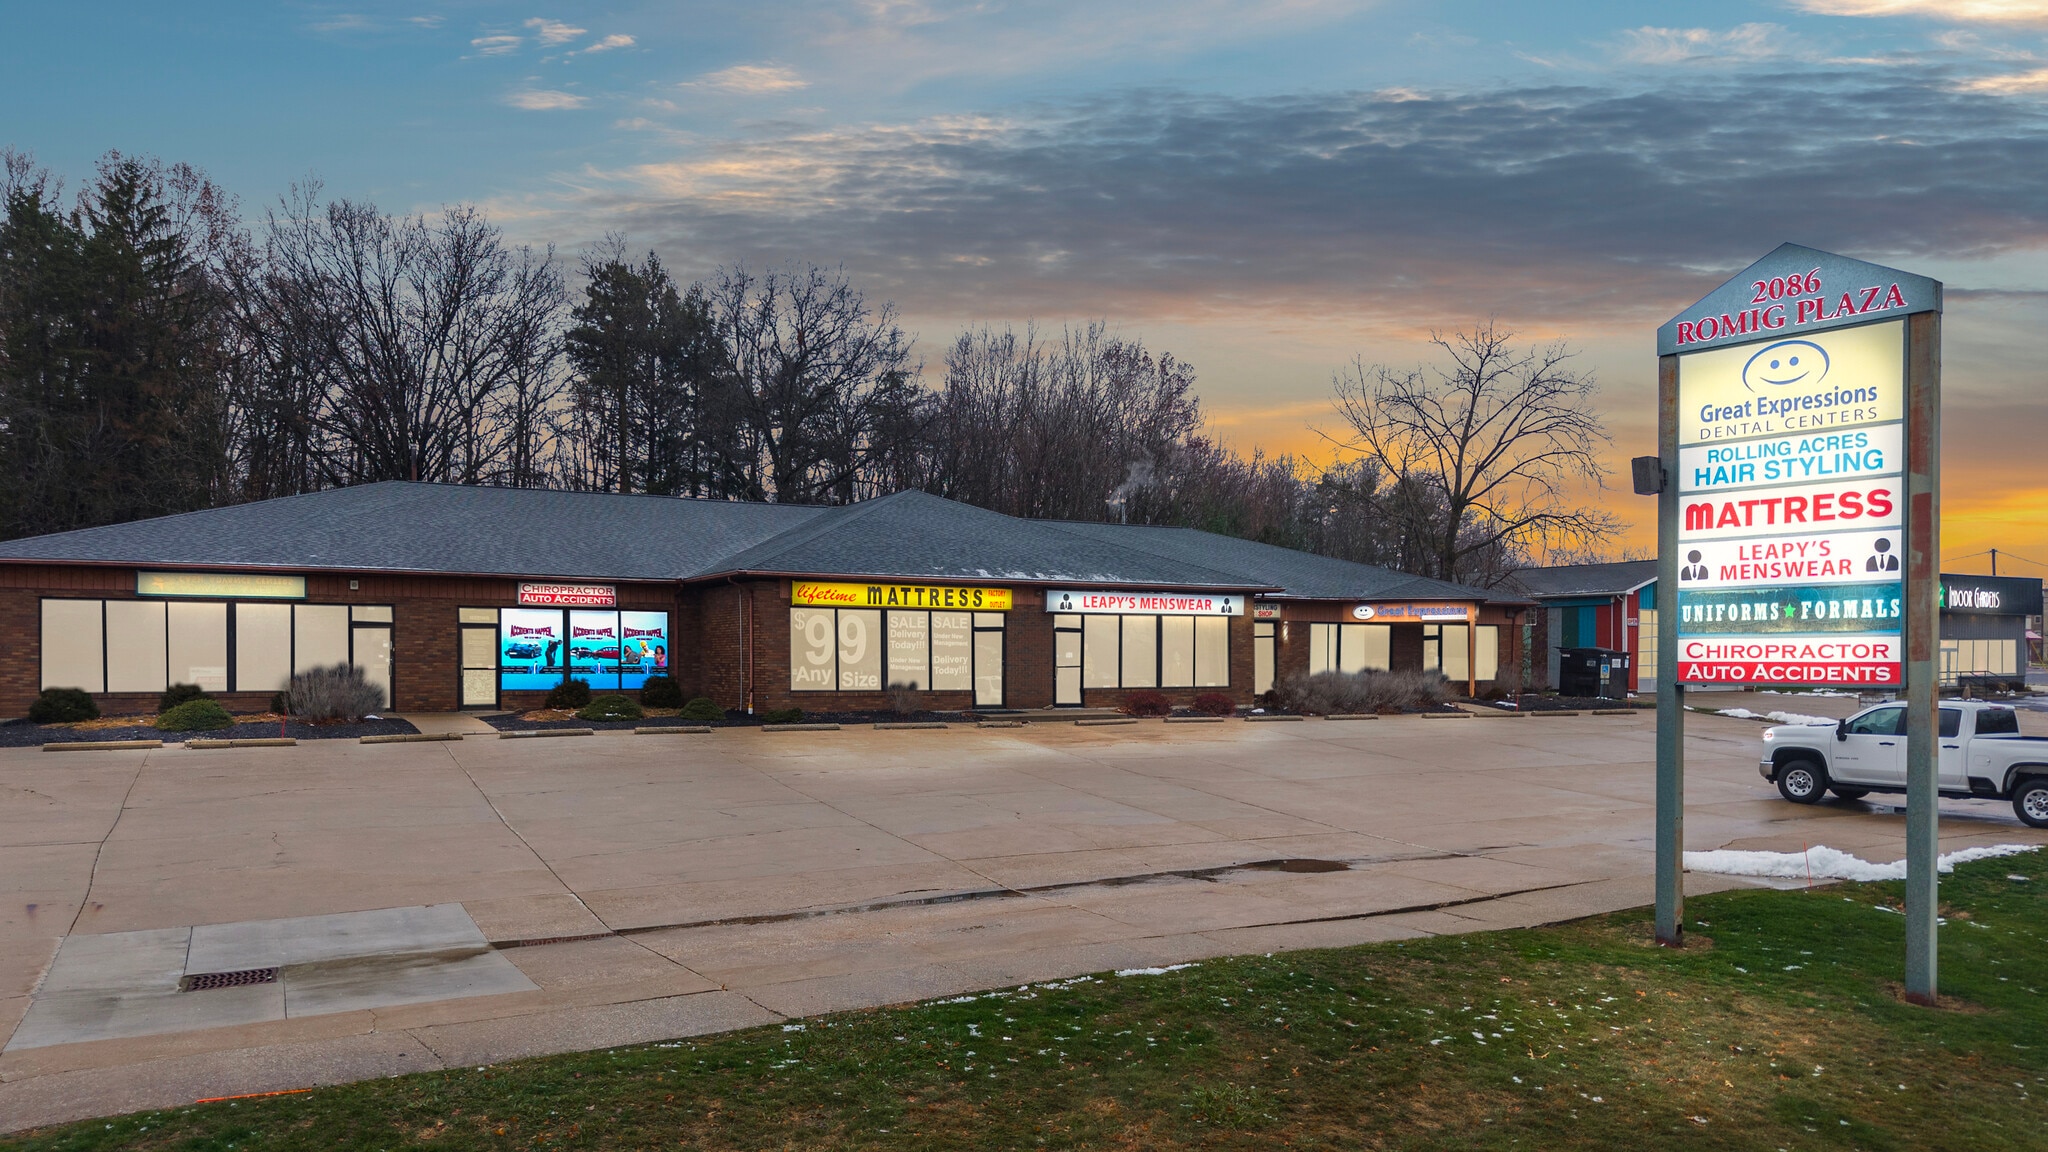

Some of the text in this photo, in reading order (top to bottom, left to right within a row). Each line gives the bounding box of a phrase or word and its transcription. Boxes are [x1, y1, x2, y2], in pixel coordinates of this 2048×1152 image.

[1750, 266, 1821, 304] 2086
[1676, 283, 1908, 346] ROMIG PLAZA
[1700, 386, 1878, 422] Great Expressions
[1700, 407, 1878, 440] DENTAL CENTERS
[1708, 432, 1868, 464] ROLLING ACRES
[1695, 450, 1884, 486] HAIR STYLING
[1686, 488, 1893, 531] MATTRESS
[1738, 540, 1830, 561] LEAPY'S
[1720, 559, 1852, 581] MENSWEAR
[522, 584, 613, 595] CHIROPRACTOR
[797, 584, 983, 608] lifetime MATTRESS
[522, 594, 614, 604] AUTO ACCIDENTS
[1084, 596, 1212, 610] LEAPY'S MENSWEAR
[1378, 605, 1404, 616] Great
[1408, 604, 1468, 618] Expressions
[1682, 598, 1900, 622] UNIFORMS FORMALS
[510, 625, 533, 637] ACCIDENTS
[890, 616, 926, 628] SALE
[934, 617, 968, 628] SALE
[573, 626, 595, 638] ACCIDENTS
[624, 627, 645, 639] ACCIDENTS
[890, 630, 926, 640] Delivery
[890, 640, 925, 650] Today!!!
[1686, 642, 1890, 660] CHIROPRACTOR
[934, 656, 968, 664] Delivery
[796, 666, 878, 687] Any Size
[934, 666, 968, 676] Today!!!
[1686, 663, 1891, 682] AUTO ACCIDENTS
